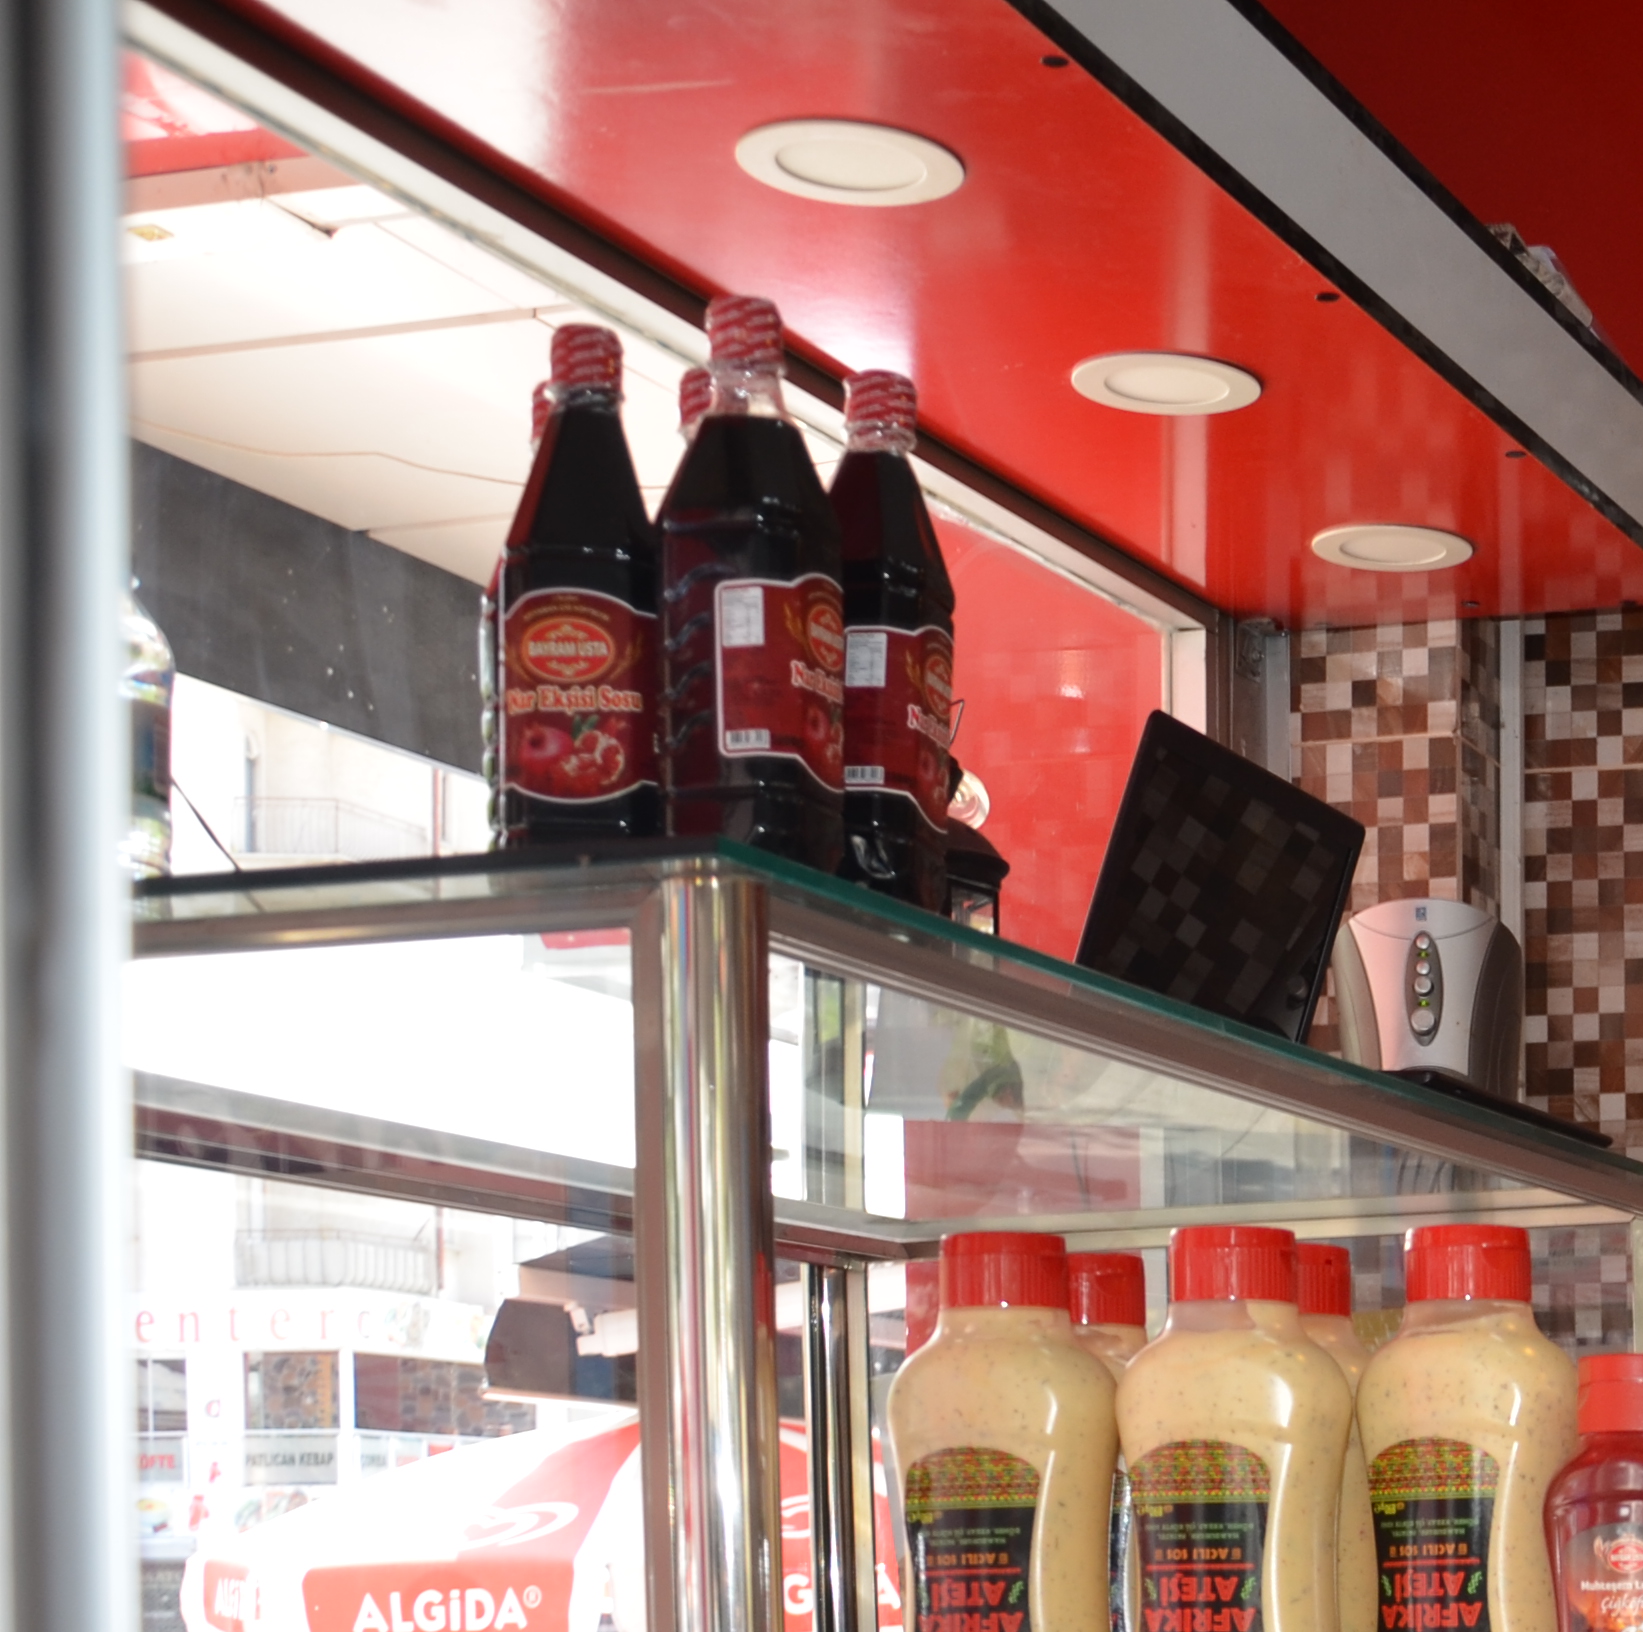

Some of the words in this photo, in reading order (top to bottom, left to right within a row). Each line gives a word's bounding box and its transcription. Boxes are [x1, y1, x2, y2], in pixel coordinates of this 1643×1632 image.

[245, 1453, 297, 1468] PATLICAN
[299, 1452, 335, 1468] KEBAP
[1381, 1602, 1483, 1632] AFRİKA
